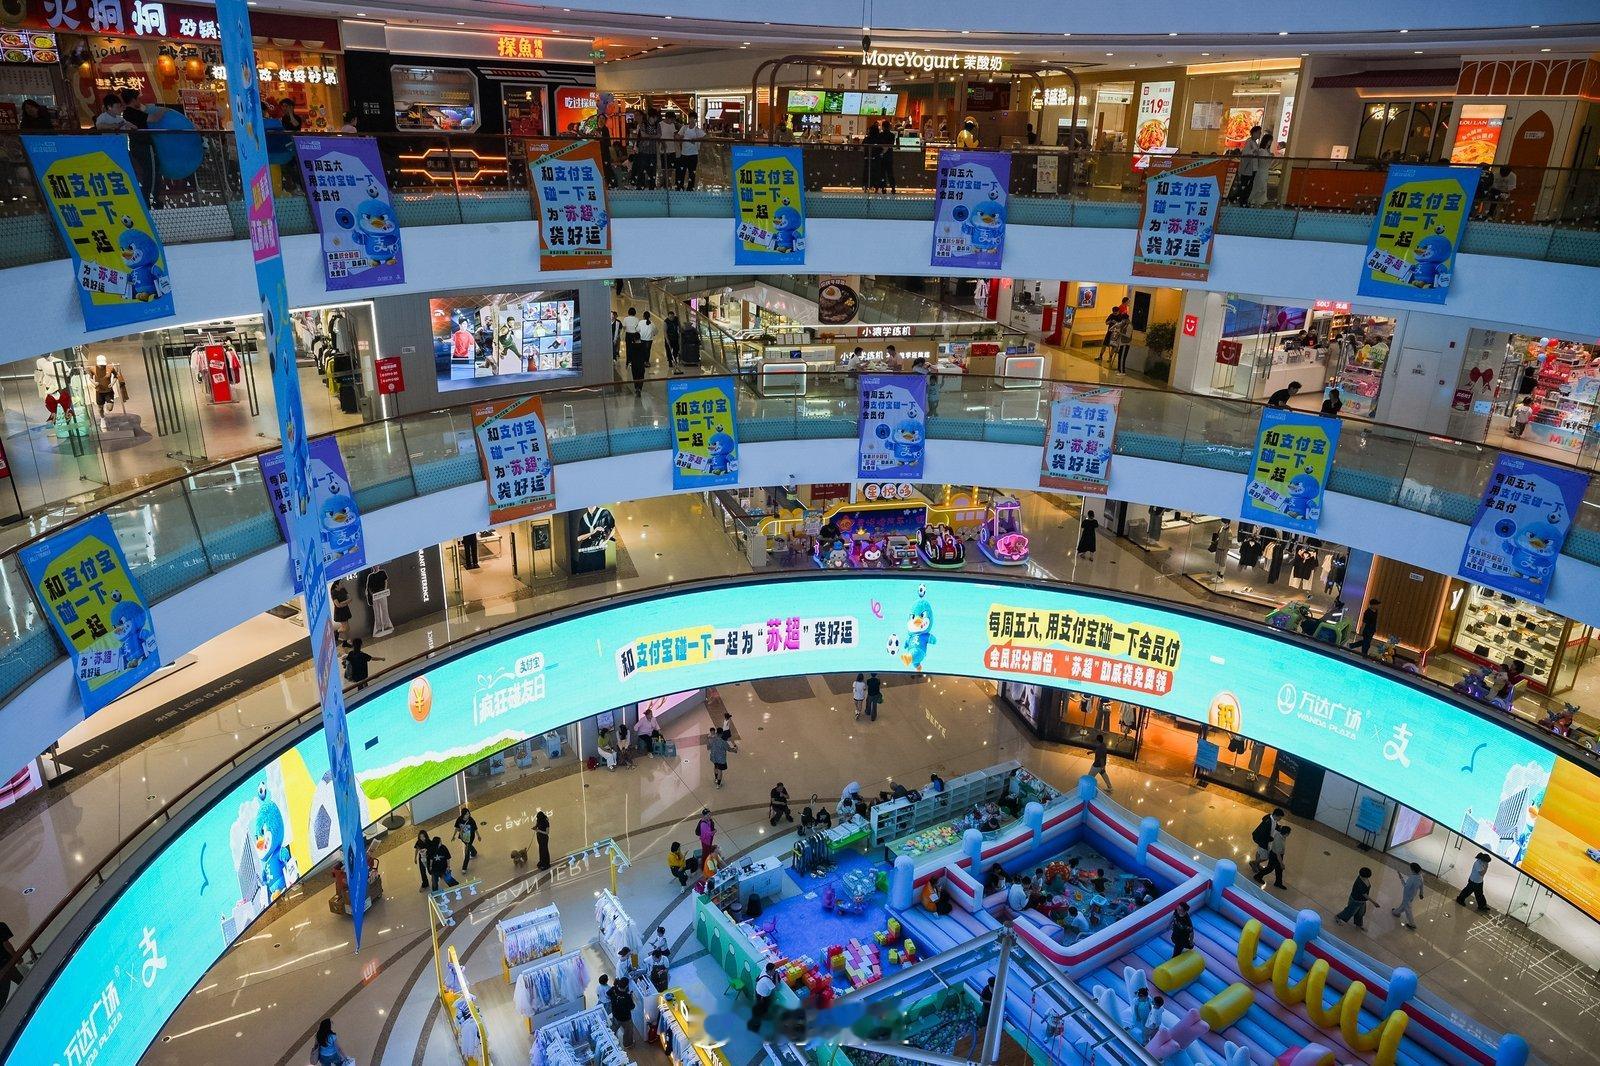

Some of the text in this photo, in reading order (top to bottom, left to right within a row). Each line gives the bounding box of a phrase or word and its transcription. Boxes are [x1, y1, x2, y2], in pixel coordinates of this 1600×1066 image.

[180, 18, 222, 39] 砂锅
[862, 50, 959, 71] MoreYogurt
[963, 55, 1002, 71] 茉酸奶
[304, 160, 343, 172] 每周五六
[541, 166, 593, 181] 和支付宝
[941, 168, 973, 178] 每周五六
[48, 171, 129, 199] 和支付宝
[309, 175, 374, 187] 用支付宝碰一下
[740, 169, 794, 185] 和支付宝
[940, 180, 998, 190] 用支付宝碰一下
[313, 190, 340, 202] 会员付
[544, 186, 584, 201] 碰一下
[587, 186, 596, 201] 一起
[741, 187, 780, 202] 碰一下
[940, 191, 964, 200] 会员付
[1155, 181, 1212, 198] 和支付宝
[1153, 200, 1196, 215] 碰一下
[1389, 190, 1462, 211] 和支付宝
[59, 201, 117, 227] 碰一下
[742, 205, 769, 219] 一起
[1198, 202, 1208, 216] 一起
[1384, 210, 1438, 230] 碰一下
[73, 230, 115, 253] 一起
[550, 226, 600, 245] 袋好运
[1380, 231, 1414, 247] 一起
[1146, 236, 1200, 257] 袋好运
[863, 391, 893, 399] 每周五六
[676, 399, 727, 415] 和支付宝
[864, 401, 916, 410] 用支付宝碰一下
[487, 420, 536, 442] 和支付宝
[677, 416, 714, 432] 碰一下
[1057, 421, 1096, 437] 碰一下
[530, 438, 539, 453] 一起
[679, 433, 703, 447] 一起
[1264, 430, 1326, 455] 和支付宝
[490, 440, 528, 460] 碰一下
[1261, 448, 1306, 468] 碰一下
[1052, 454, 1100, 474] 袋好运
[1257, 467, 1287, 483] 一起
[1496, 473, 1536, 492] 每周五六
[497, 475, 545, 500] 袋好运
[1485, 499, 1517, 514] 会员付
[1490, 485, 1564, 513] 用支付宝碰一下
[44, 549, 116, 601] 和支付宝
[56, 581, 107, 625] 碰一下
[71, 614, 108, 641] 一起
[520, 657, 540, 673] 支付宝
[1300, 690, 1362, 732] 万达广场
[1296, 712, 1357, 740] WANDA PLAZA
